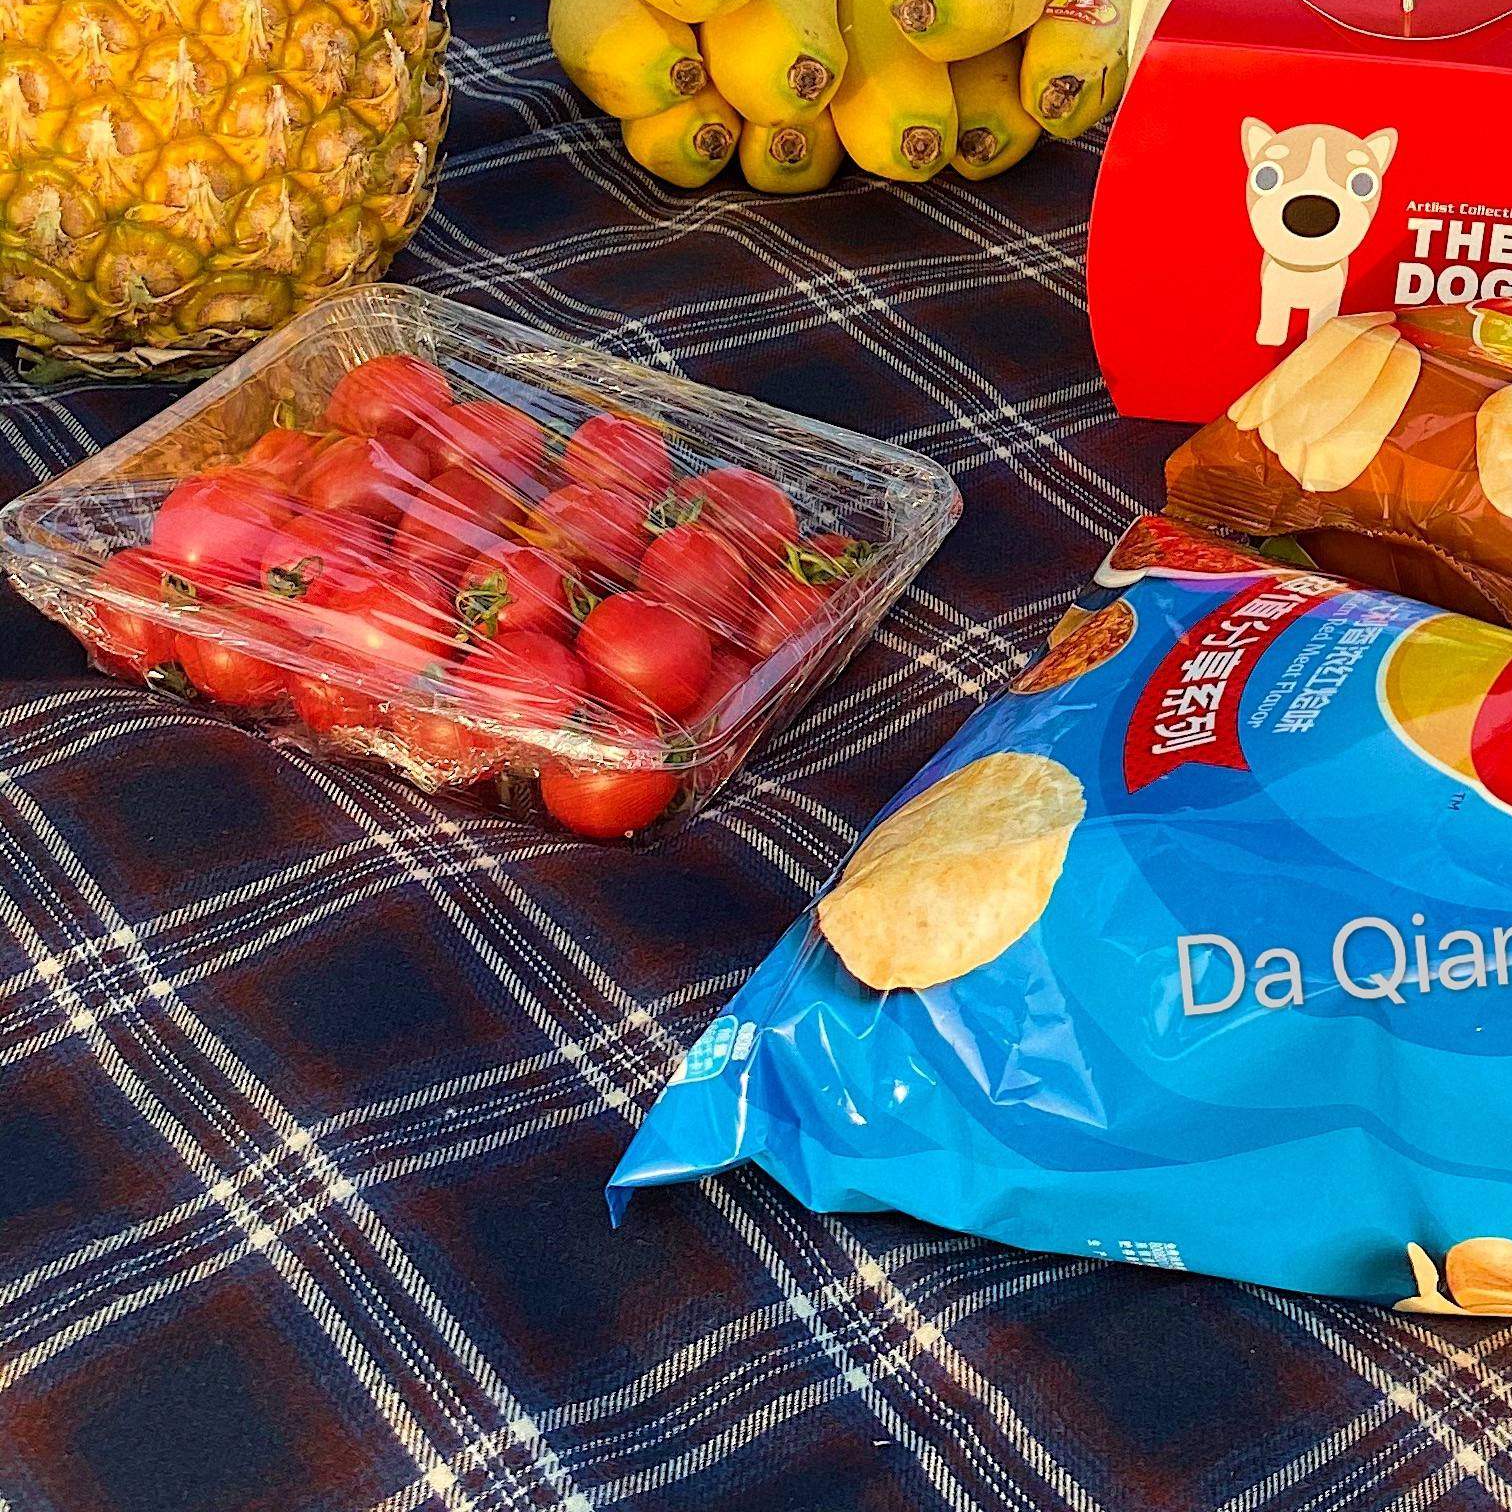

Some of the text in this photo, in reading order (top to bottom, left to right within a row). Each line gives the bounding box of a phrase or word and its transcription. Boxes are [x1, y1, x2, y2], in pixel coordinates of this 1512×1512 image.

[1246, 618, 1344, 729] Red Meat Flavor
